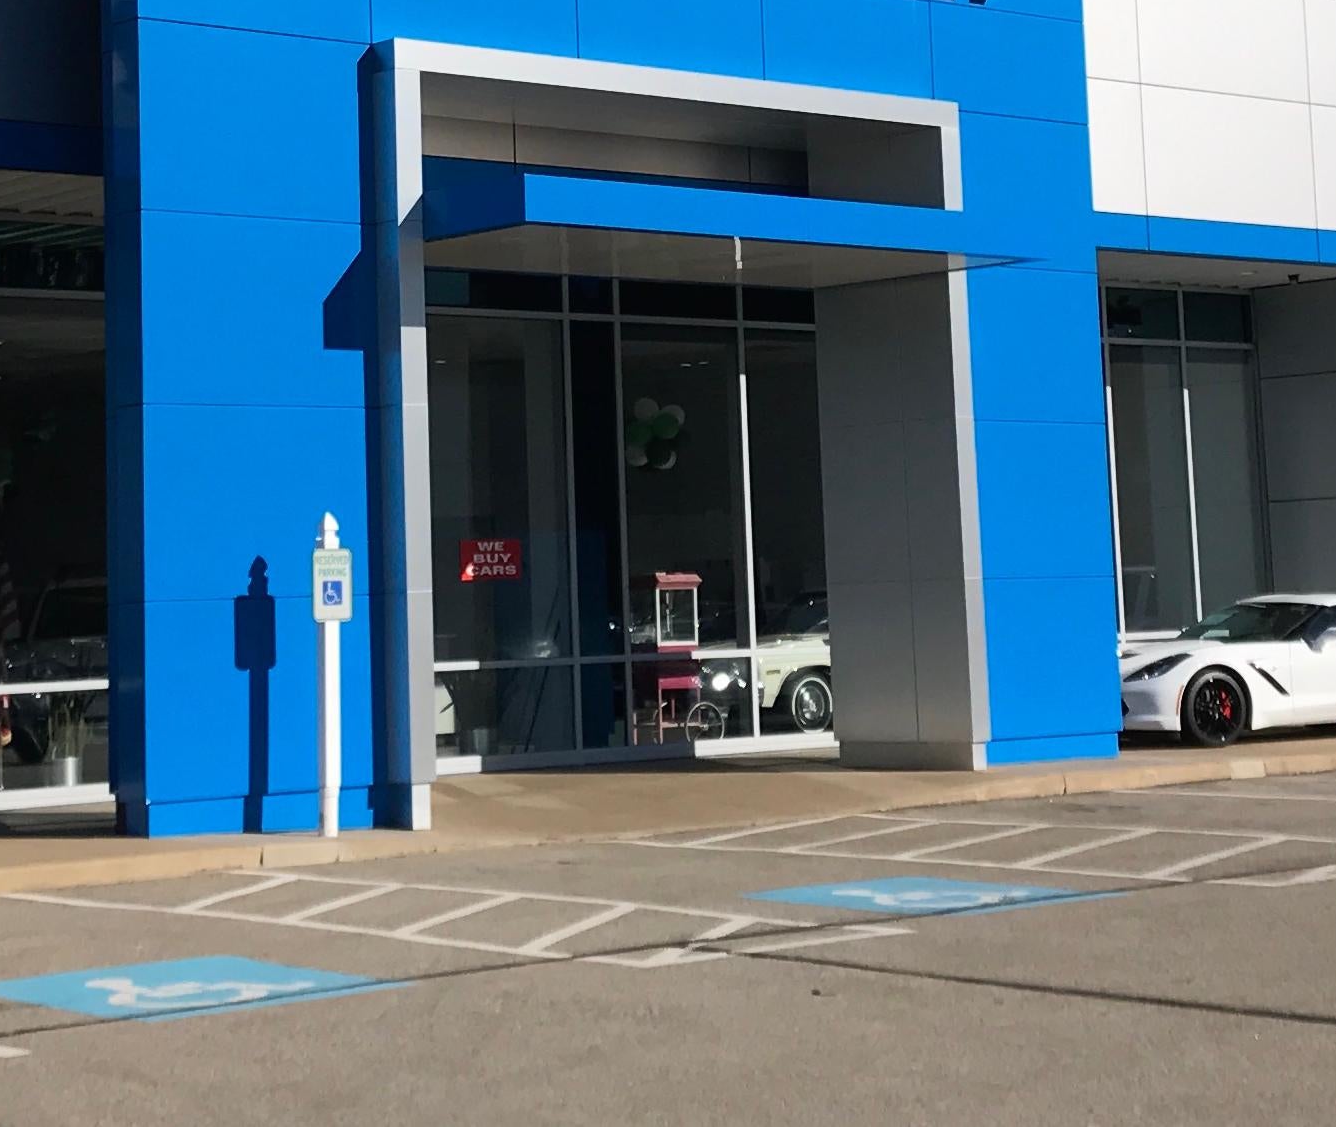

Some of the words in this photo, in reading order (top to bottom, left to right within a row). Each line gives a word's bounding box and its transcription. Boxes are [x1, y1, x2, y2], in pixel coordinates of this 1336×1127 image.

[477, 541, 504, 551] WE
[473, 553, 511, 563] BUY
[467, 565, 517, 576] CARS
